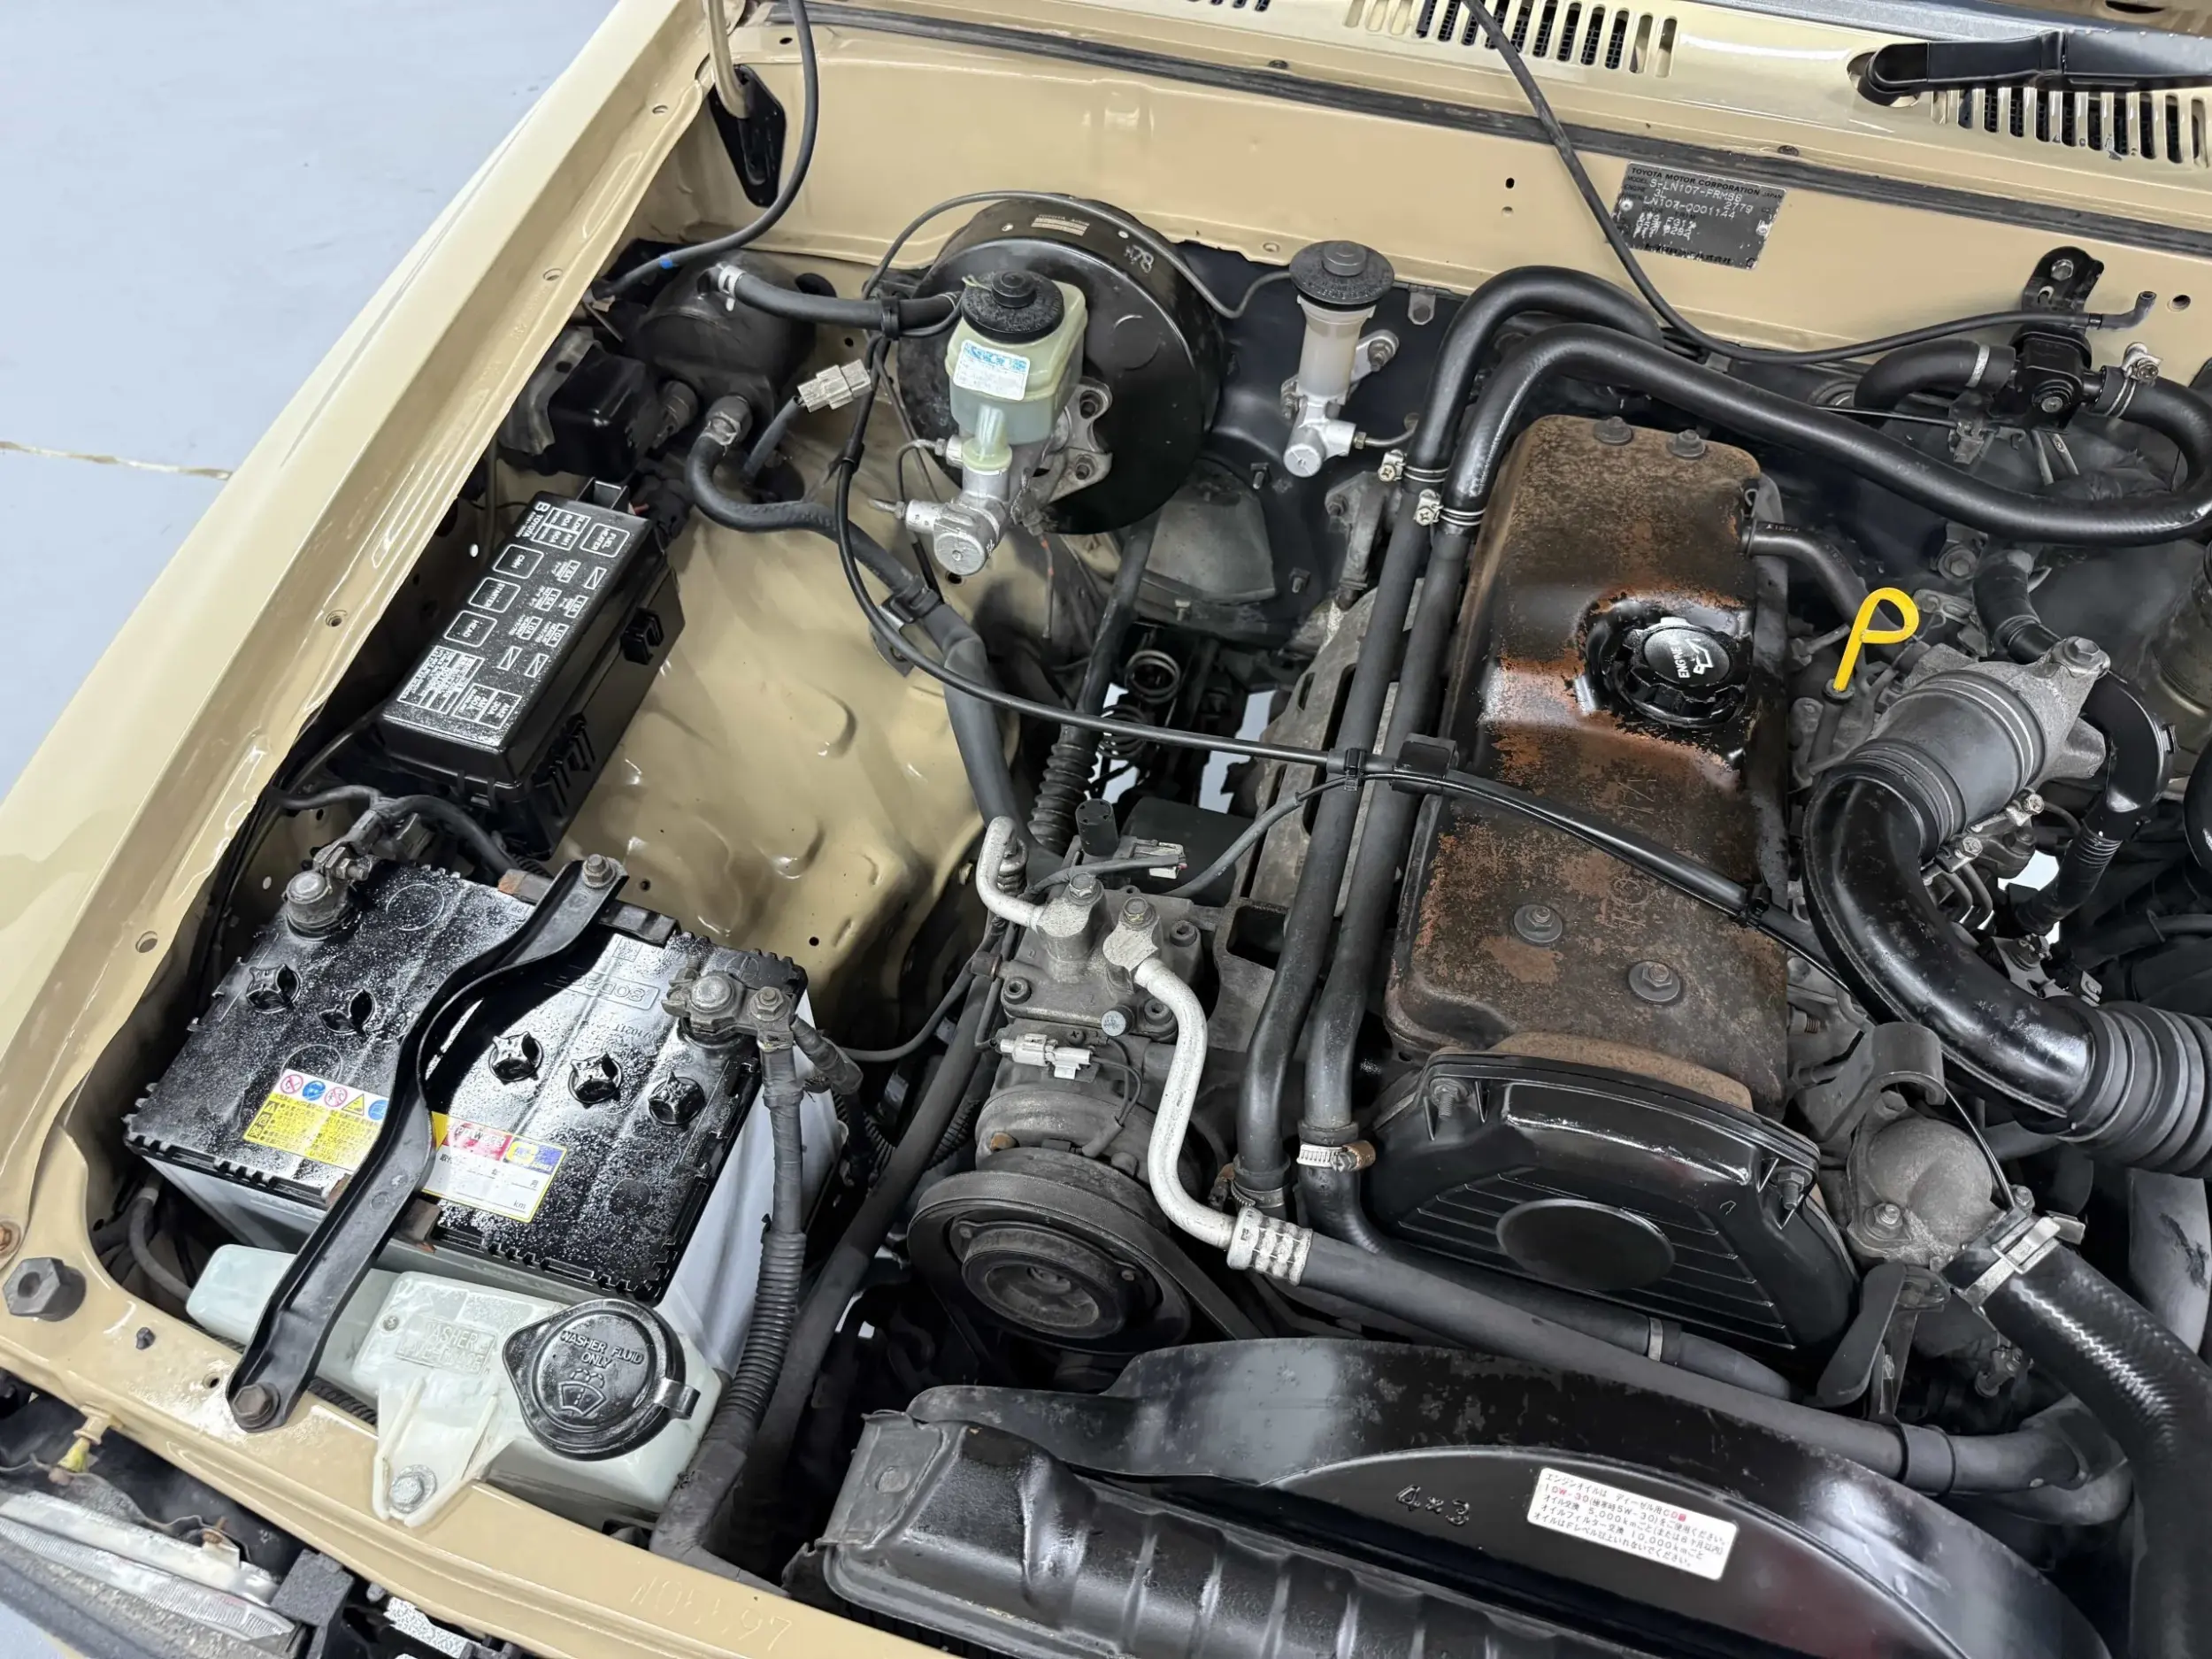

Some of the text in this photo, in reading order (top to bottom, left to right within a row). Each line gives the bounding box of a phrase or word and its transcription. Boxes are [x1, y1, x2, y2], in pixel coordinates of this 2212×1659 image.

[1632, 167, 1663, 179] TOYOTA
[1665, 173, 1695, 184] MOTOR
[1698, 180, 1760, 196] CORPORATION
[1653, 189, 1667, 199] 3L
[533, 501, 551, 512] B
[521, 513, 543, 537] TOYOTA
[588, 527, 612, 550] HEATER
[600, 533, 618, 549] FUEL
[482, 582, 505, 607] STARTER
[461, 618, 480, 638] HEAD
[523, 621, 537, 634] 10A
[549, 628, 565, 641] 10A
[1671, 647, 1690, 678] ENGINE
[513, 1200, 526, 1210] km
[559, 1329, 645, 1365] WASHER FLUID
[580, 1351, 612, 1369] ONLY
